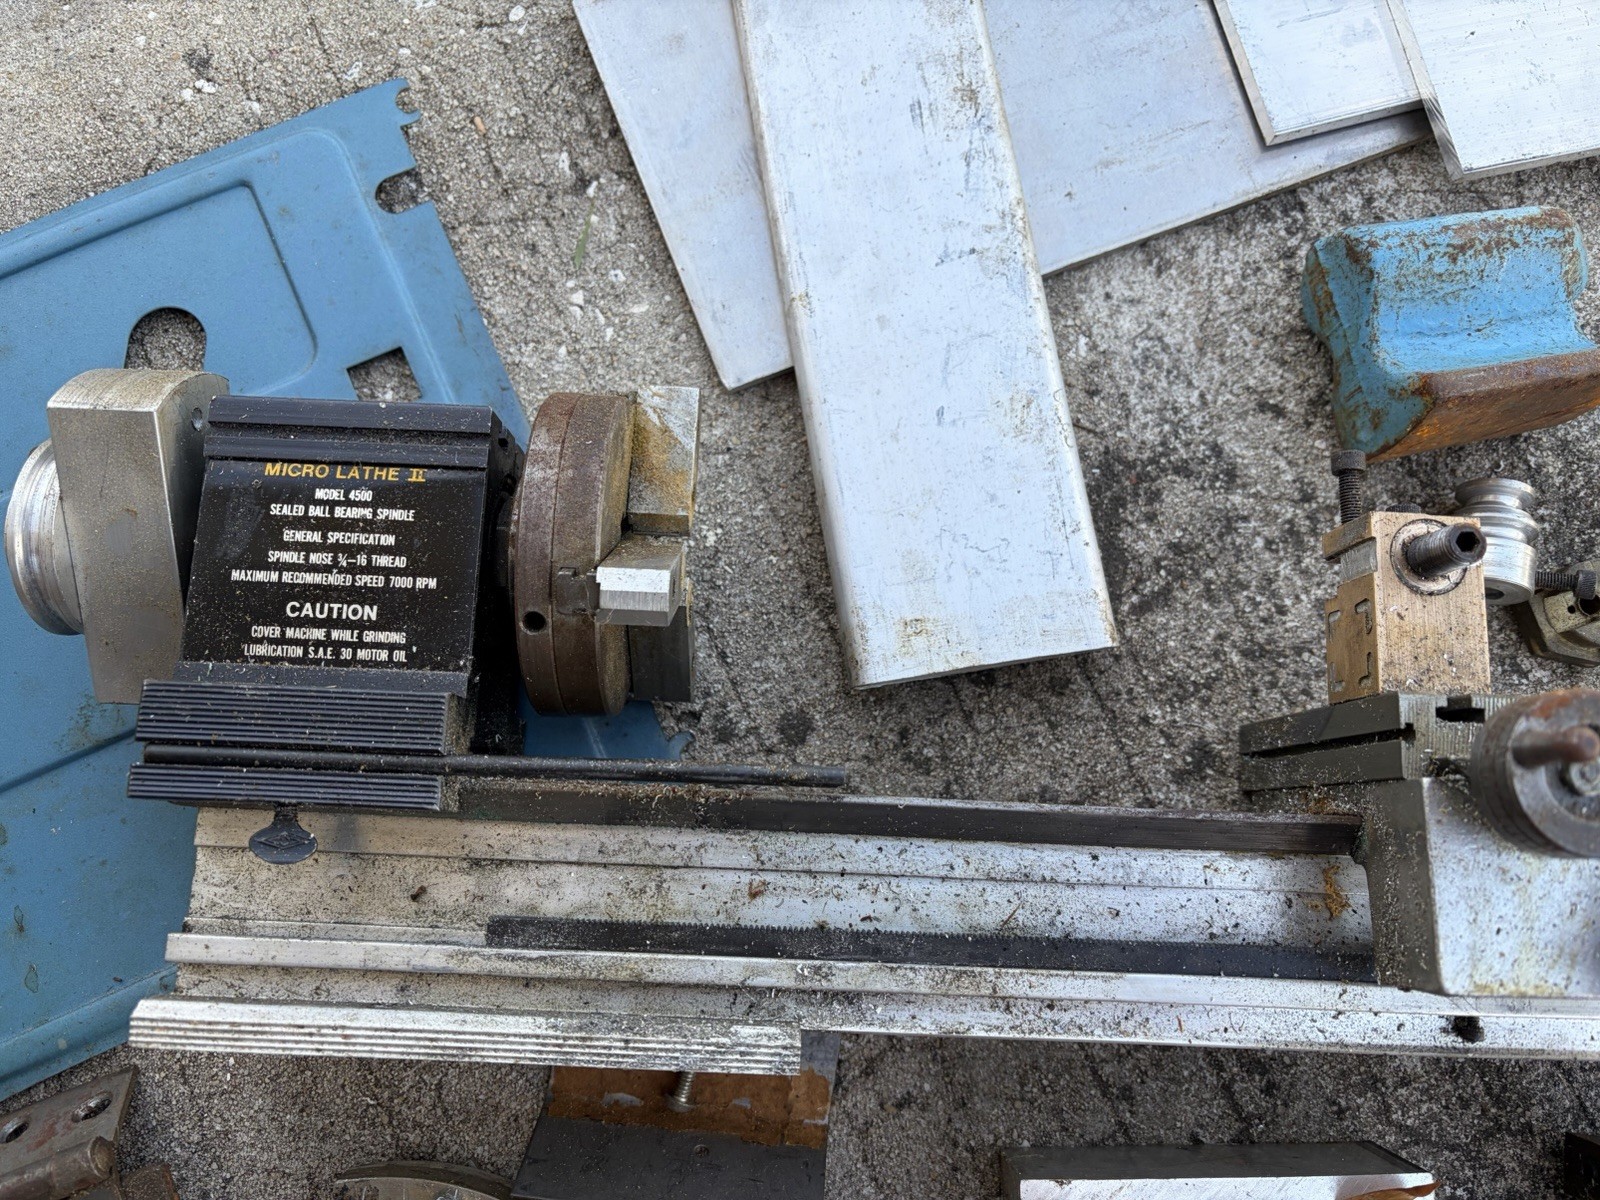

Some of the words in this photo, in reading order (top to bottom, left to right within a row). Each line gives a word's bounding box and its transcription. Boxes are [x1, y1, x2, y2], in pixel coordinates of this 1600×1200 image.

[265, 463, 329, 477] MICRO
[336, 465, 400, 481] LATHE
[407, 468, 427, 482] II
[315, 488, 345, 500] MODEL
[349, 490, 373, 501] 4500
[270, 504, 304, 515] SEALED
[309, 506, 330, 517] BALL
[334, 507, 373, 519] BEARING
[377, 509, 415, 521] SPINDLE
[283, 529, 323, 542] GENERAL
[327, 531, 395, 545] SPECIFICATION
[268, 551, 305, 563] SPINDLE
[309, 553, 333, 564] NOSE
[371, 555, 407, 568] THREAD
[231, 569, 279, 583] MAXIMUM
[282, 571, 351, 585] RECOMMENDED
[355, 575, 384, 586] SPEED
[389, 576, 413, 588] 7000
[416, 577, 437, 589] RPM
[286, 602, 378, 620] CAUTION
[251, 626, 281, 638] COVER
[285, 627, 327, 640] MACHINE
[331, 629, 359, 641] WHILE
[363, 631, 406, 643] GRINDING
[244, 644, 303, 657] LUBRICATION
[308, 647, 335, 659] S.A.E.
[340, 648, 352, 659] 30
[357, 649, 389, 661] MOTOR
[393, 650, 407, 662] OIL
